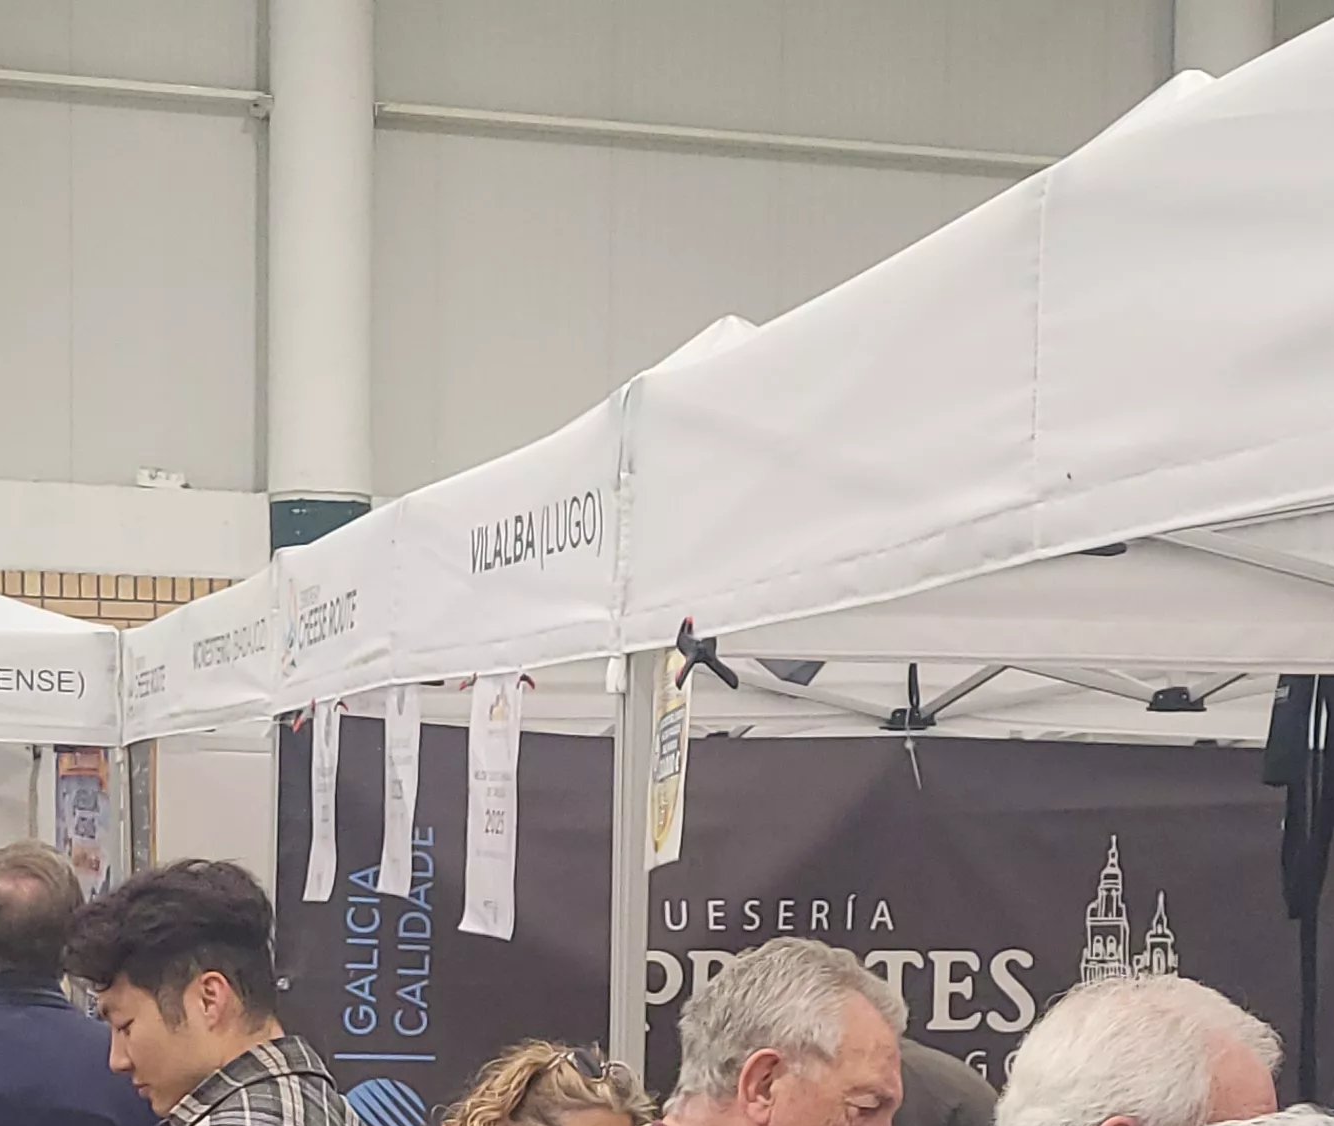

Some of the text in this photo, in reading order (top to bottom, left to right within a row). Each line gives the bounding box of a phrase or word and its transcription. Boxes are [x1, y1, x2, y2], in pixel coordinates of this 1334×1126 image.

[471, 487, 603, 574] VILALBA (LUGO)
[344, 826, 436, 1037] GALICIA CALIDADE
[664, 893, 896, 931] UESERÍA
